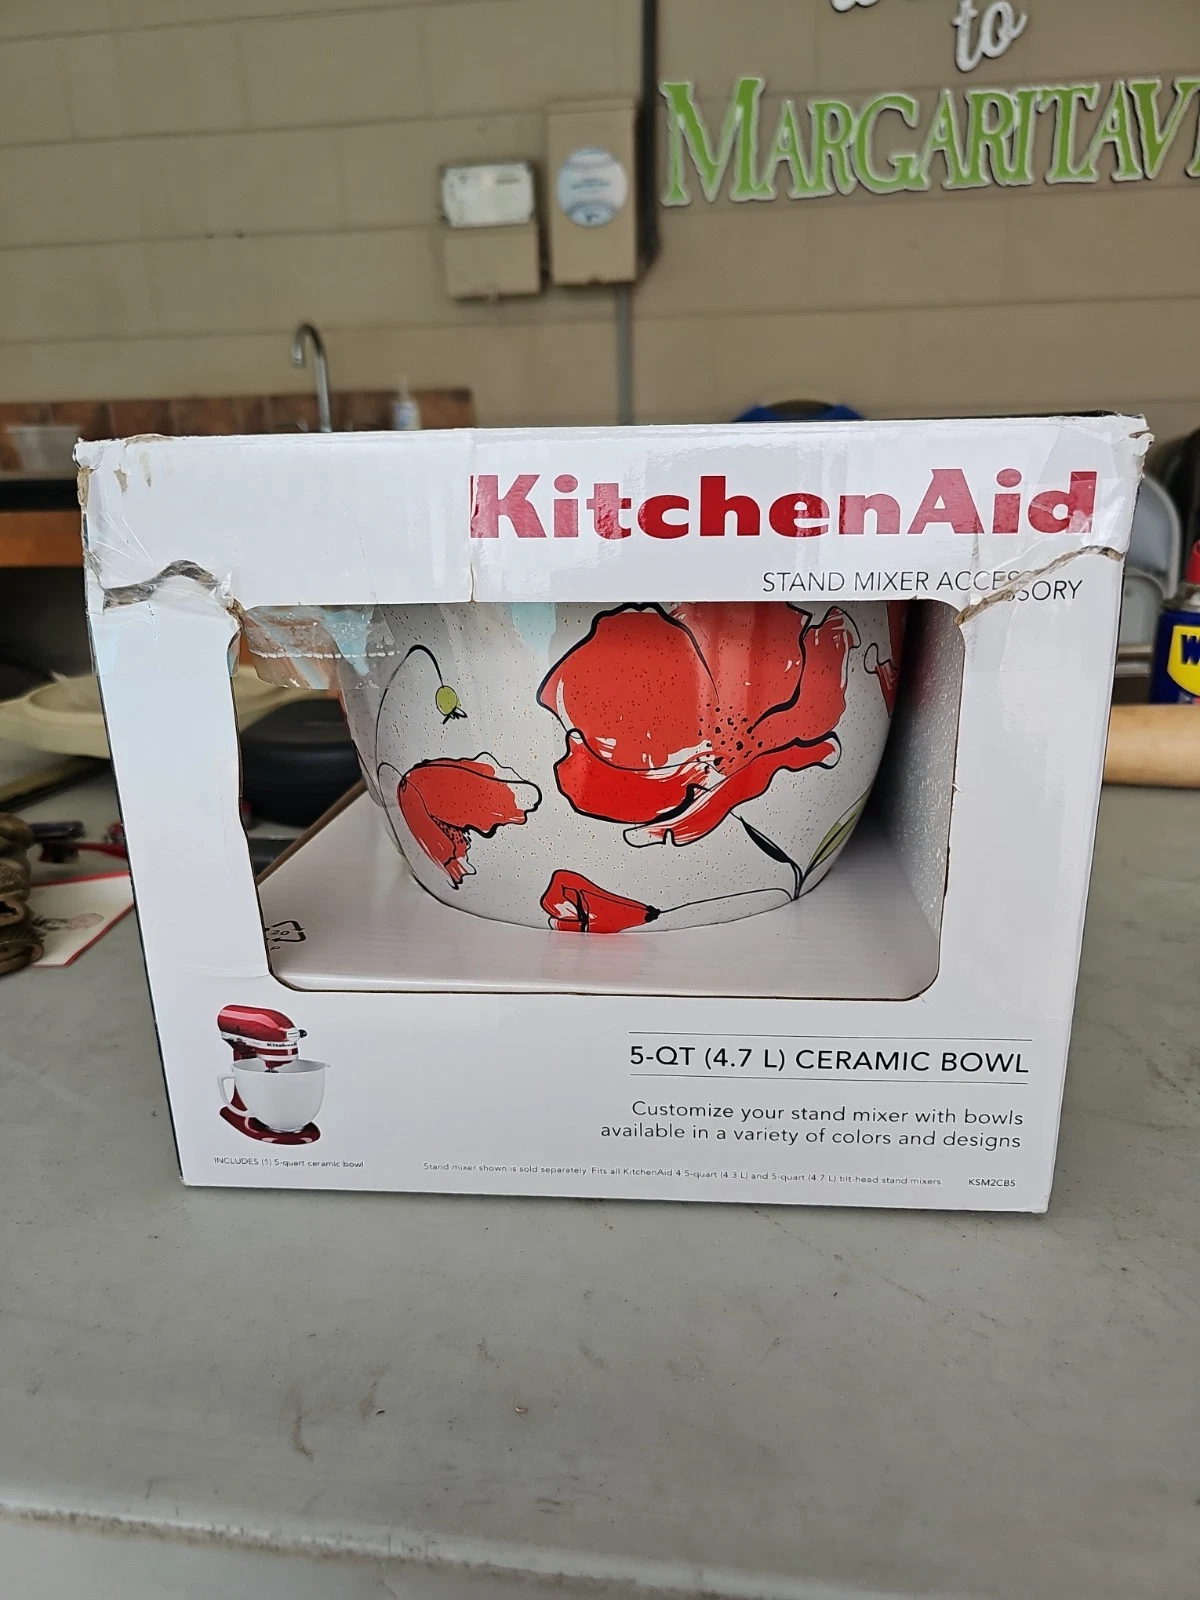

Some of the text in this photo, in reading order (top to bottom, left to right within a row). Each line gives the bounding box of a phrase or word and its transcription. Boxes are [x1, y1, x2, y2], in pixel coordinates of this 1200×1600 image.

[952, 0, 1027, 72] to
[660, 77, 1200, 206] MARGARITAV
[470, 468, 1097, 540] KitchenAid
[762, 572, 845, 592] STAND
[854, 572, 929, 592] MIXER
[630, 1046, 1029, 1073] 5-QT (4.7 L) CERAMIC BOWL
[632, 1101, 1023, 1126] Customize your stand mixer with bowls
[600, 1122, 1021, 1151] available in a variety of colors and designs
[213, 1156, 260, 1166] INCLUDES
[274, 1158, 305, 1168] 5-quart
[307, 1160, 341, 1168] ceramic
[343, 1160, 364, 1168] bowl
[423, 1162, 450, 1171] Stand
[452, 1164, 477, 1172] mixer
[479, 1164, 508, 1172] shown
[520, 1165, 538, 1173] sold
[591, 1166, 608, 1175] Fits
[610, 1167, 621, 1175] all
[623, 1168, 673, 1177] KitchenAid
[751, 1172, 769, 1180] and
[771, 1172, 805, 1183] 5-quart
[839, 1174, 879, 1183] tilt-head
[881, 1176, 908, 1185] stand
[968, 1178, 1016, 1188] KSM2CB5
